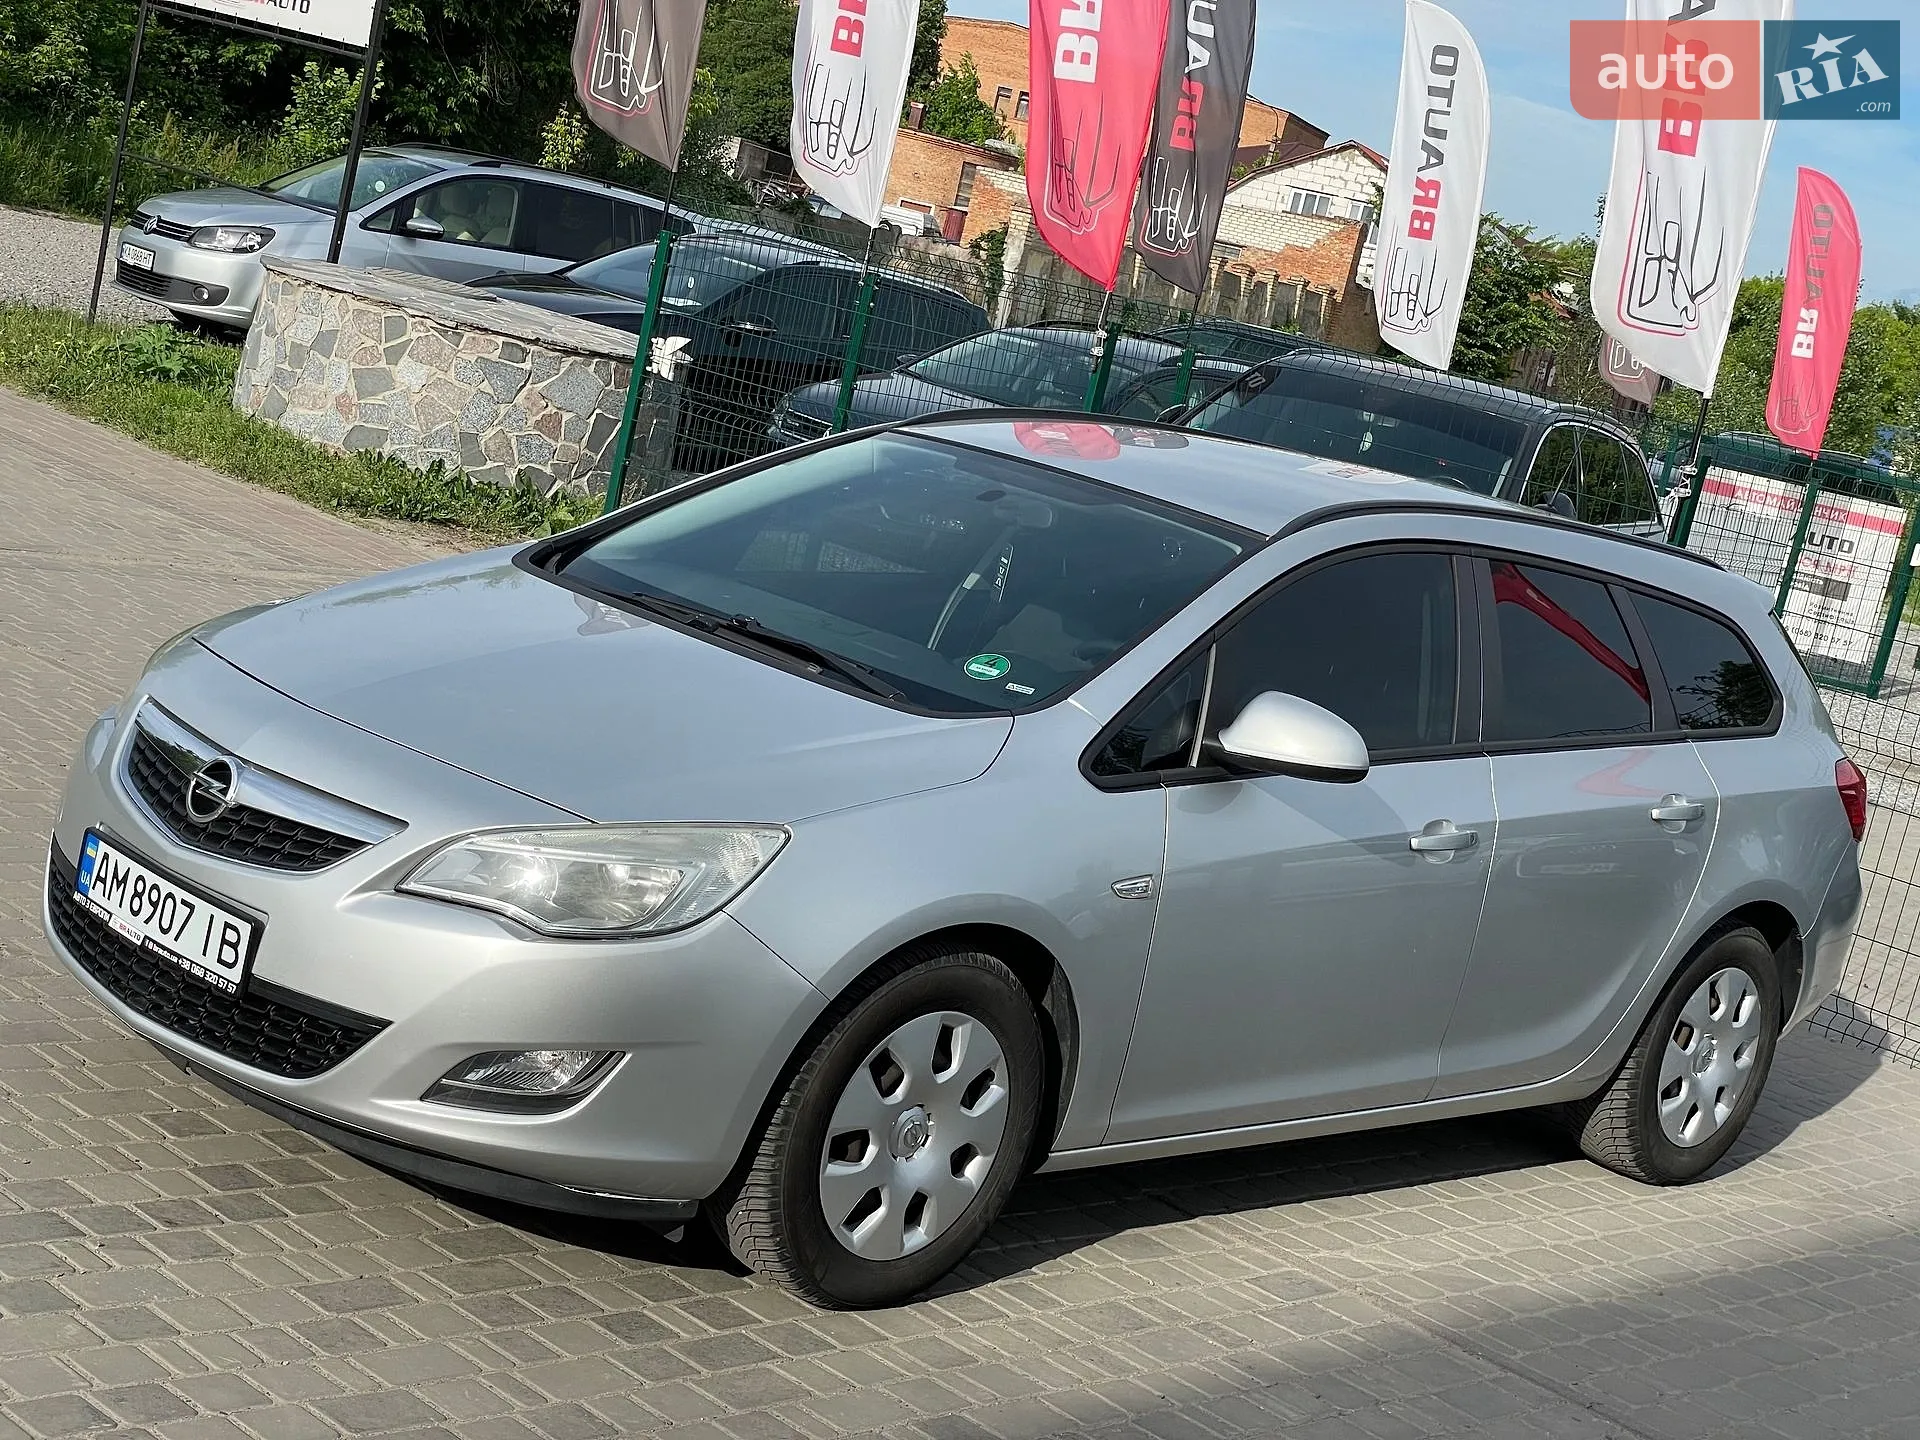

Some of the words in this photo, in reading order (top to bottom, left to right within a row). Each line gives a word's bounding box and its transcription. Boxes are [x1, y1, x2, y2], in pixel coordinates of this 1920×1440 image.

[81, 870, 91, 888] UA
[191, 964, 205, 978] 068
[204, 970, 218, 985] 320
[218, 977, 227, 989] 57
[227, 982, 236, 994] 57
